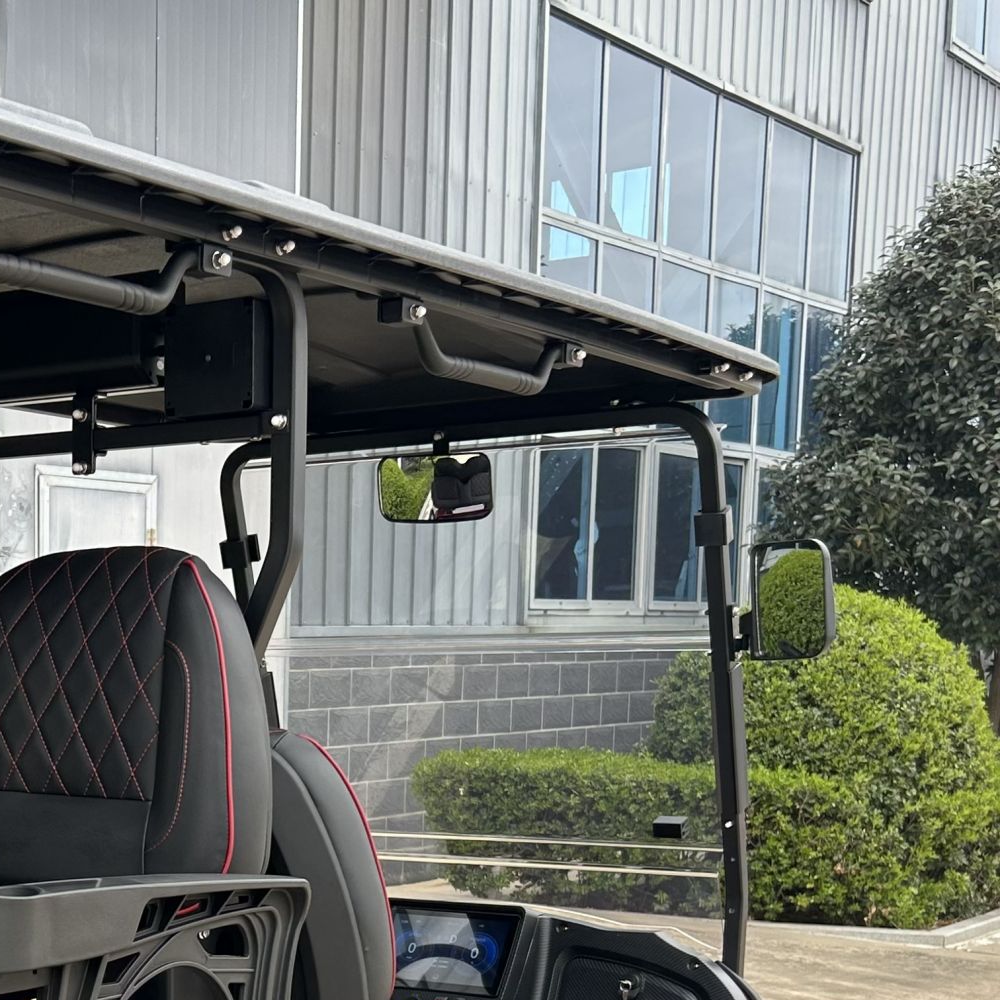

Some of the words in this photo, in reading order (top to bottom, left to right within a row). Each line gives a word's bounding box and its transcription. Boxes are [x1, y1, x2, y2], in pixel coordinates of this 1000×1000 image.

[448, 934, 457, 944] D
[407, 942, 417, 953] 0
[470, 947, 479, 959] 0
